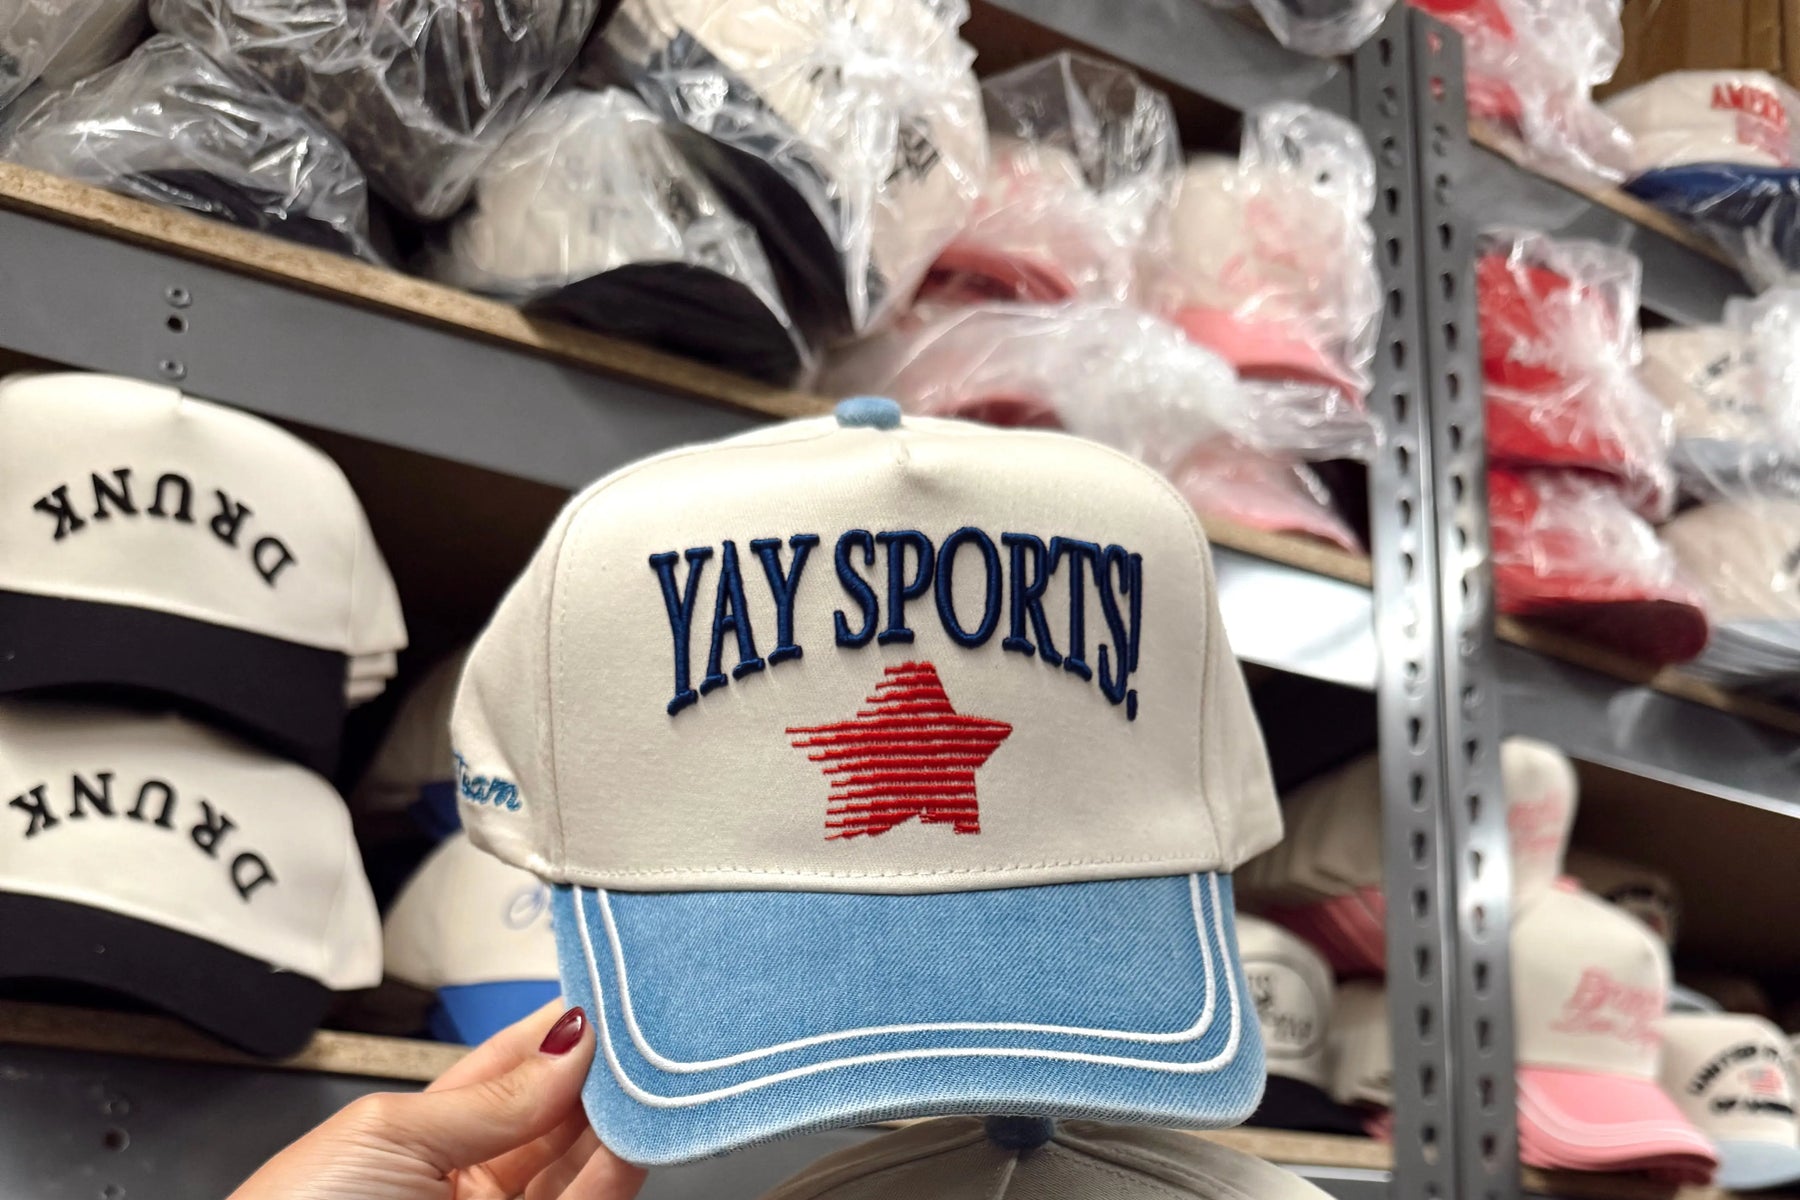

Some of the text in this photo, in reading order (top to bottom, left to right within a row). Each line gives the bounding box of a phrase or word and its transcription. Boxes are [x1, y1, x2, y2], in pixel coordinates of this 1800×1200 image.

[33, 467, 297, 587] DRUNK
[649, 526, 1143, 721] YAY SPORTS!
[8, 771, 278, 903] DRUNK
